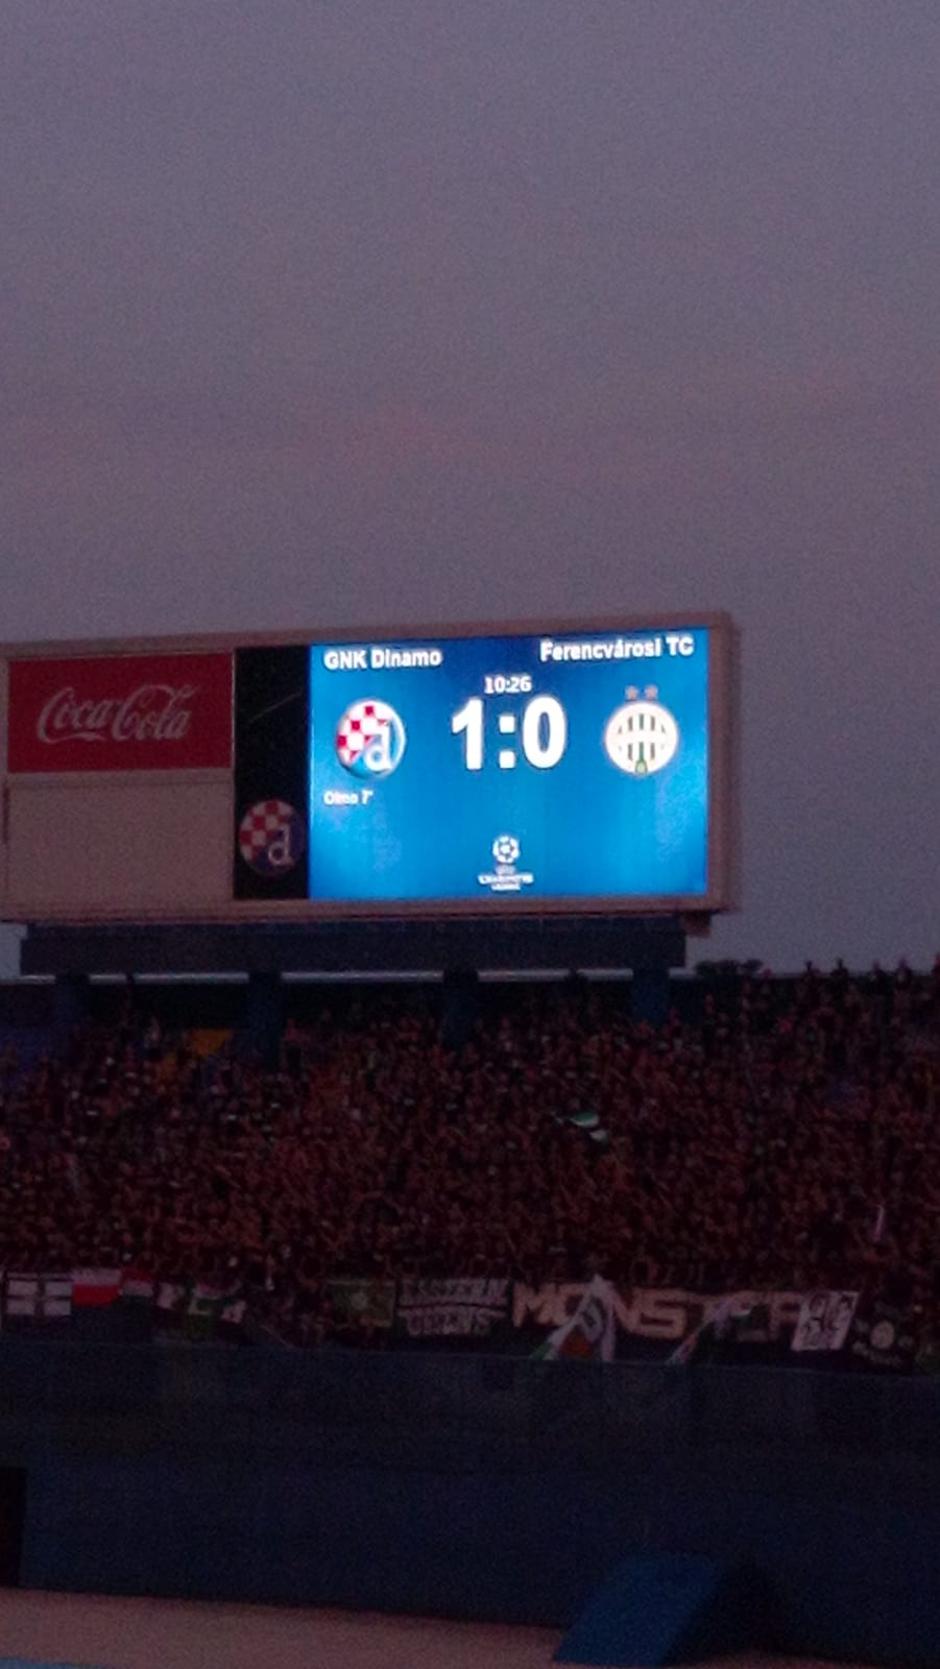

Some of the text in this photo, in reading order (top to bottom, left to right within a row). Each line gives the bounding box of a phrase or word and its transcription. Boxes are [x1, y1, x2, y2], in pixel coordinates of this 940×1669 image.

[665, 633, 694, 656] TC
[324, 647, 443, 670] GNK Dinamo
[484, 675, 532, 694] 10:26
[451, 694, 567, 770] 1:0
